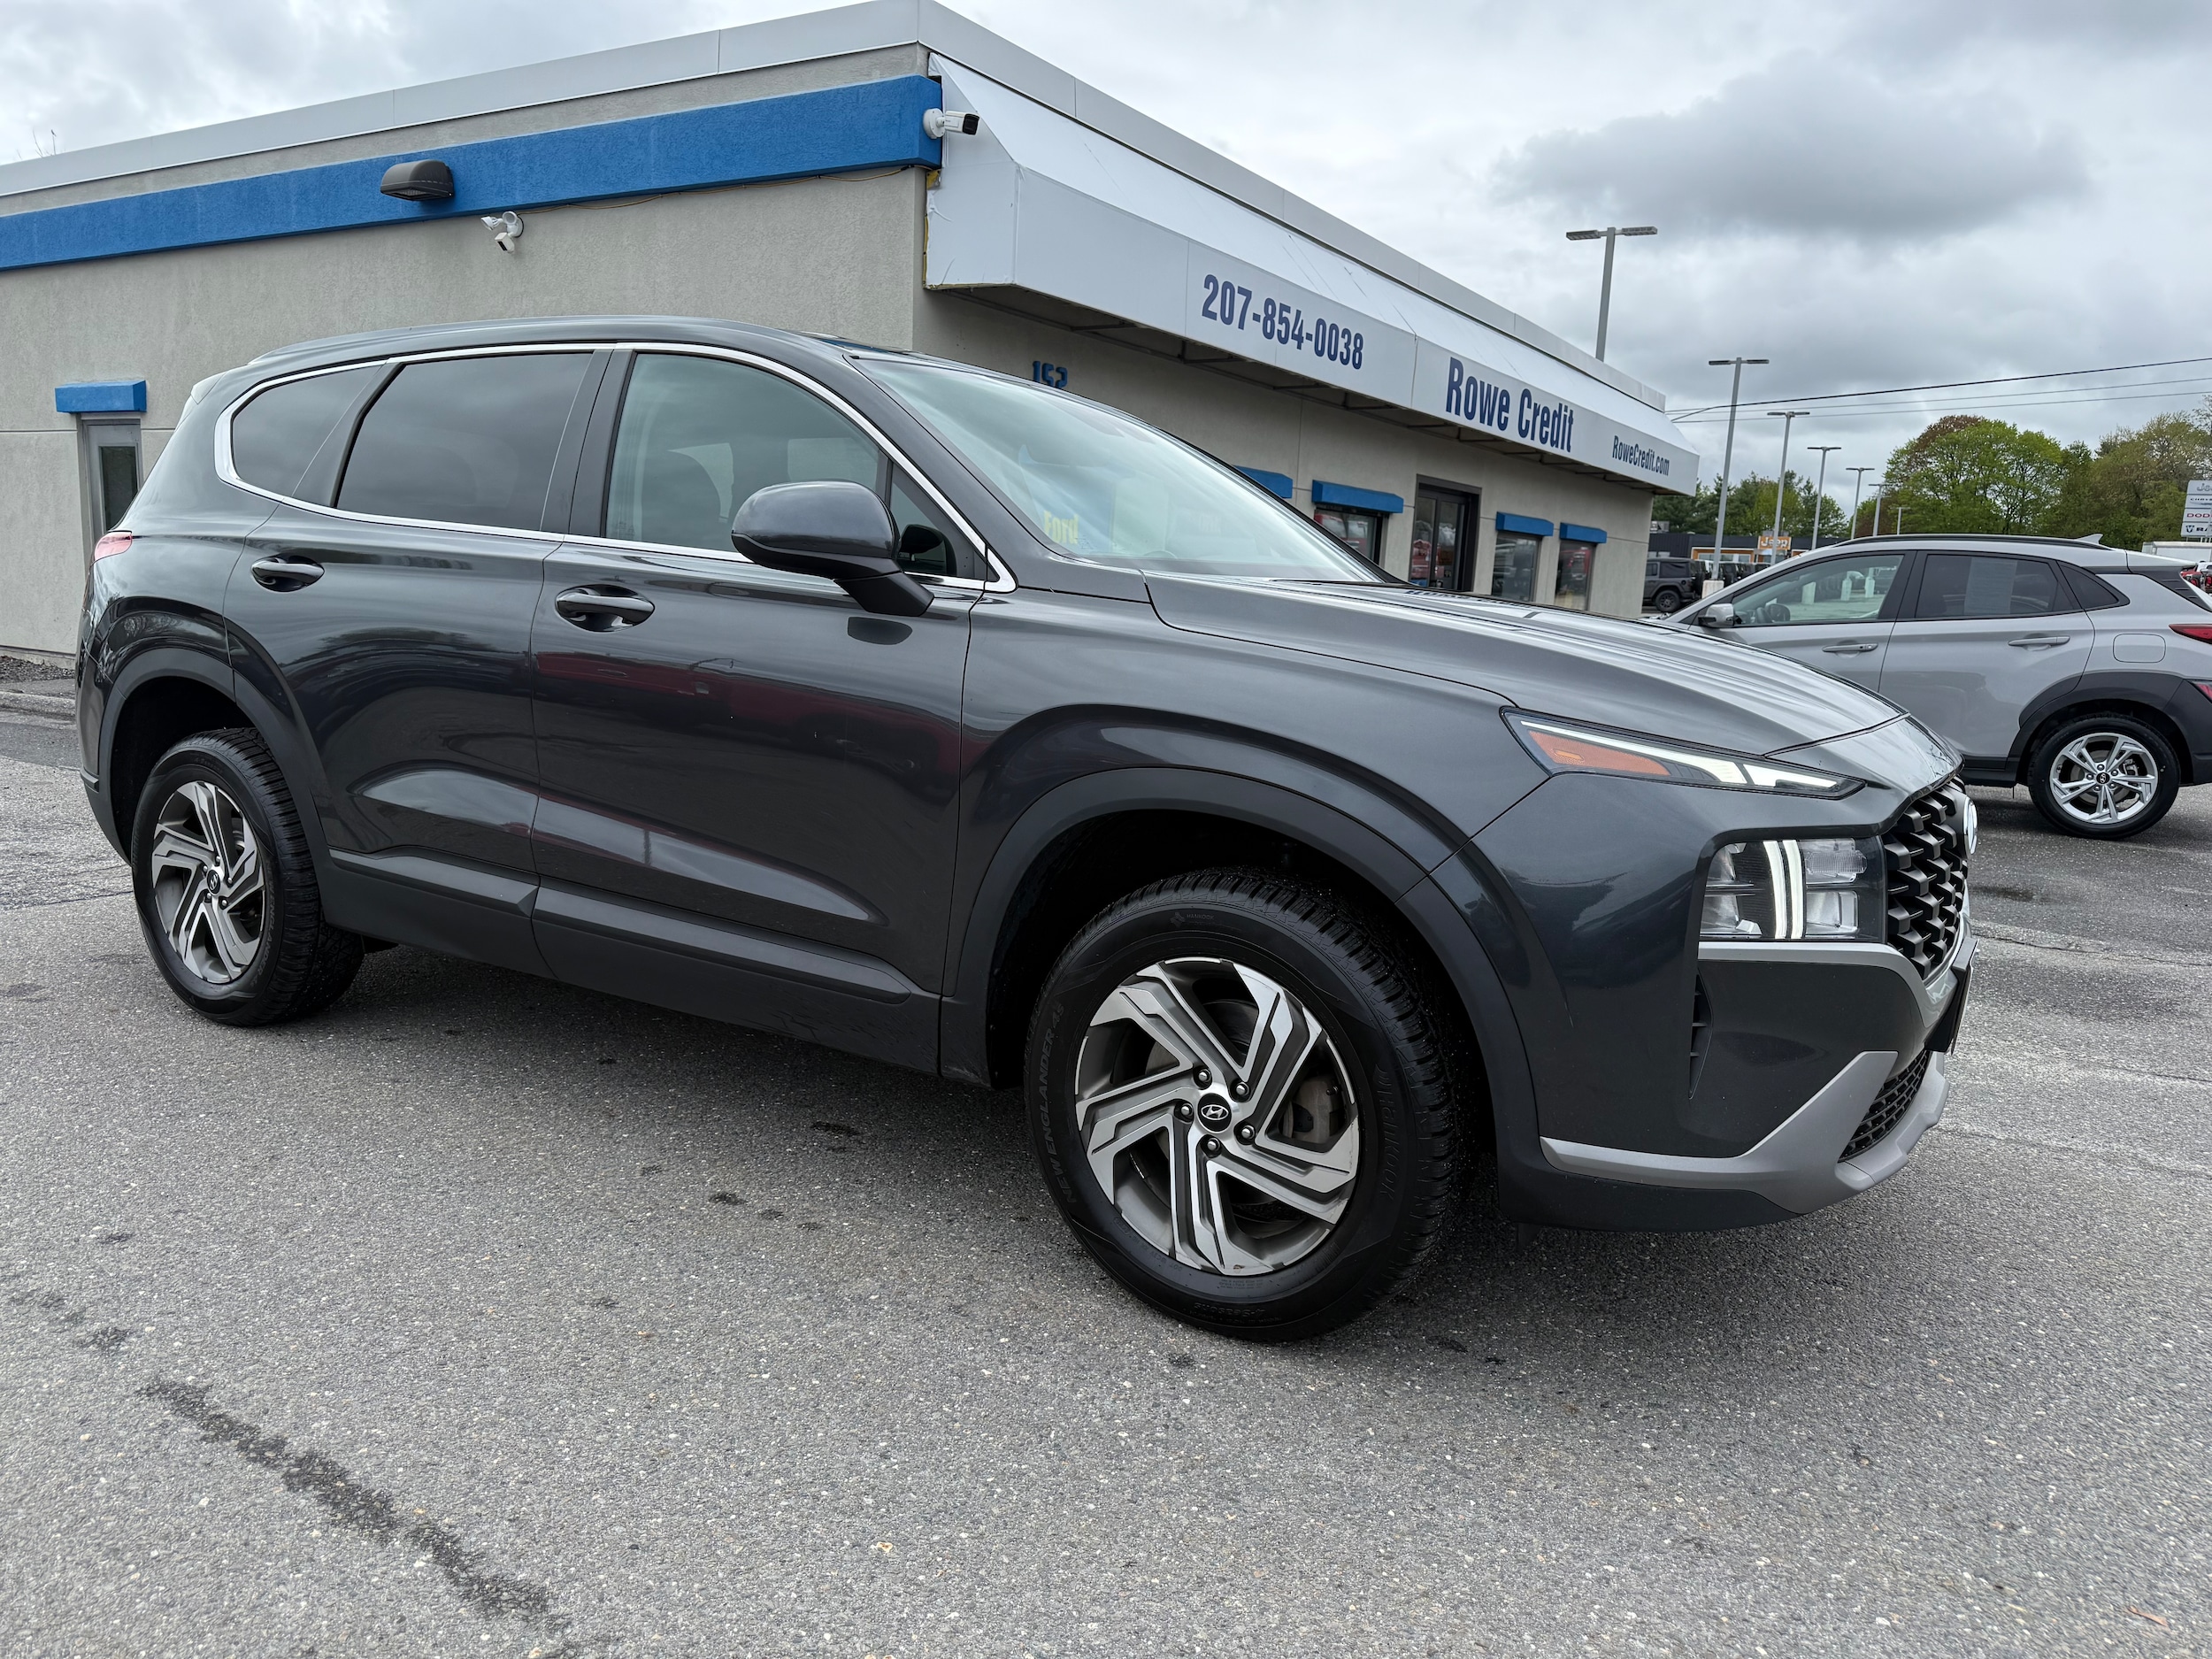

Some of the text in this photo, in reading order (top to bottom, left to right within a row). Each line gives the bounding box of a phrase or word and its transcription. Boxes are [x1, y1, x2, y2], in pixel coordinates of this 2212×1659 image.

[1201, 273, 1364, 370] 207-854-0038
[1033, 360, 1068, 388] 152
[1445, 356, 1574, 453] Rowe Credit
[1612, 434, 1671, 477] RoweCredit.com
[1761, 536, 1788, 548] Jeep
[1038, 1027, 1059, 1156] ENGLANDER
[1052, 1156, 1078, 1204] NEW
